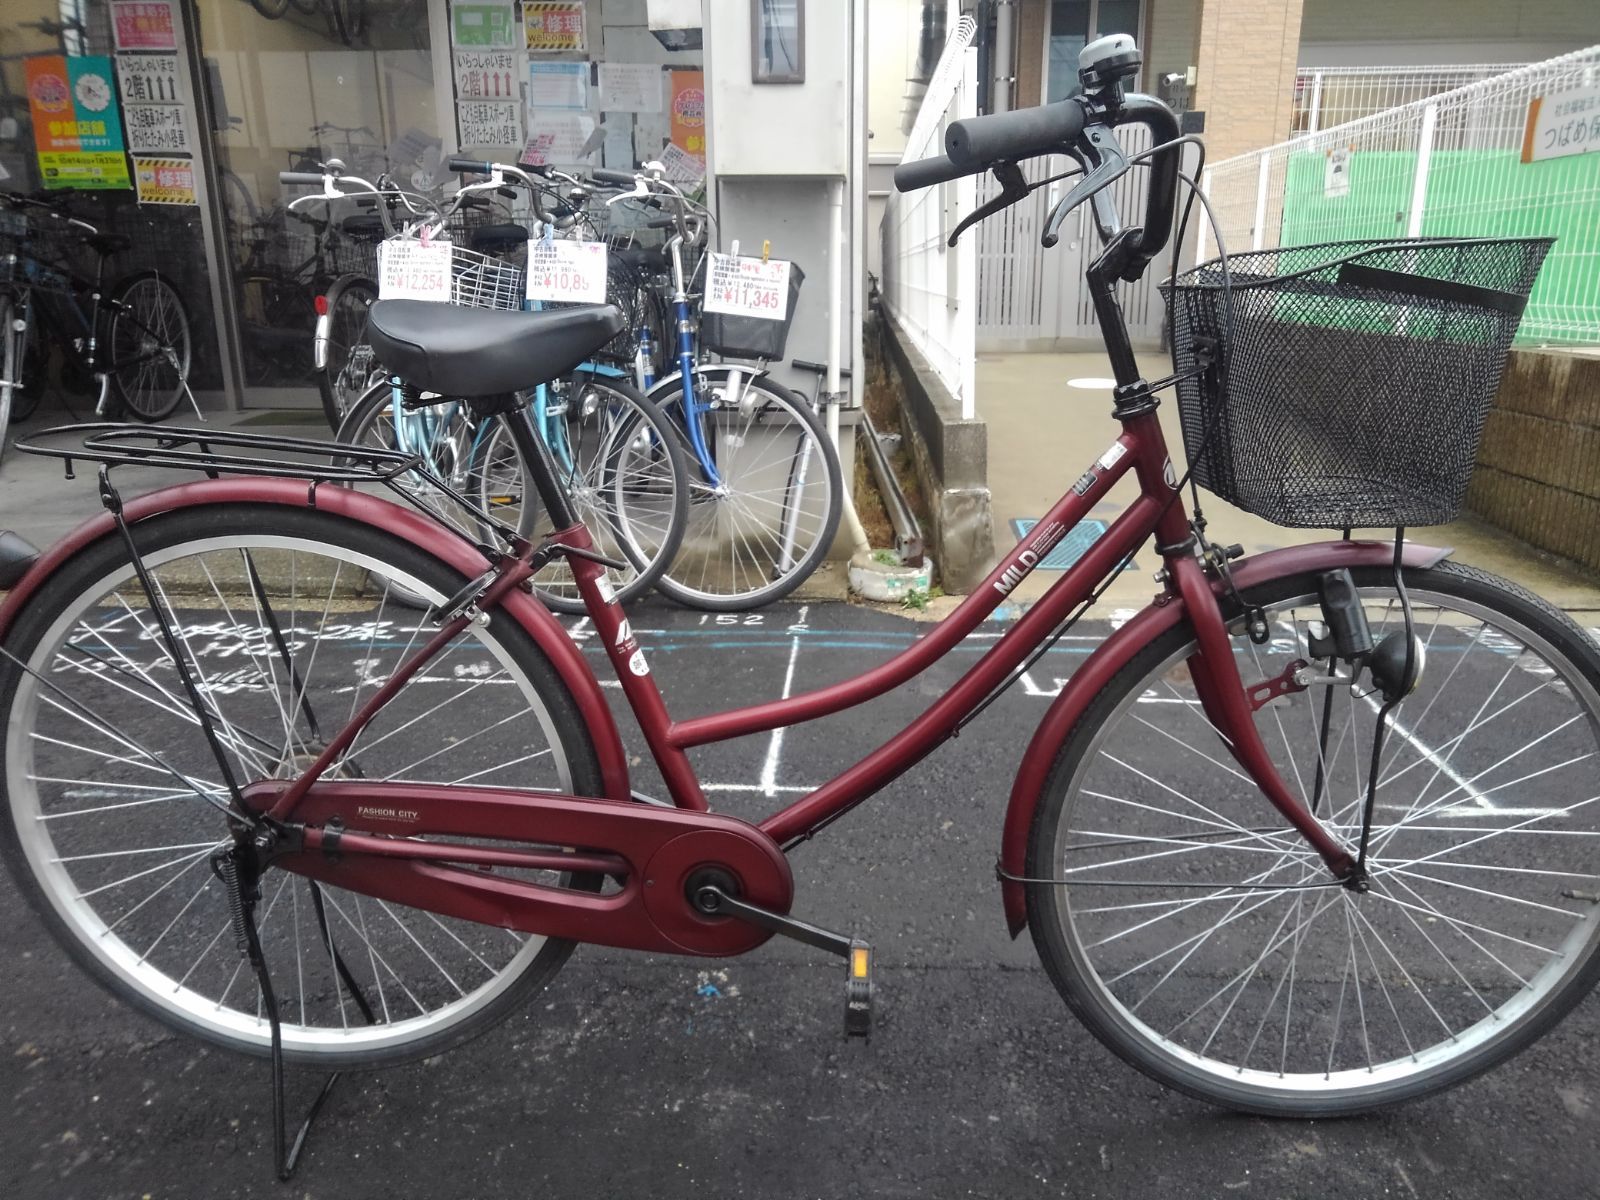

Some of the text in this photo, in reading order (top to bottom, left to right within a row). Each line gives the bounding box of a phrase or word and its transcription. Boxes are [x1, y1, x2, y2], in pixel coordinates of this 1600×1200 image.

[546, 14, 581, 33] 修理
[528, 33, 575, 42] welcome
[119, 56, 175, 72] いらっしゃいませ
[457, 54, 512, 69] いらっしゃいませ
[125, 74, 146, 100] 2階
[461, 71, 481, 96] 2階
[464, 125, 518, 145] 折りたたみ小径車
[158, 170, 193, 187] 修理
[141, 187, 186, 196] welcome
[397, 274, 443, 291] ¥12,254
[723, 287, 779, 309] ¥11,345
[993, 550, 1038, 596] MILD
[358, 806, 418, 819] FASHION CITY
